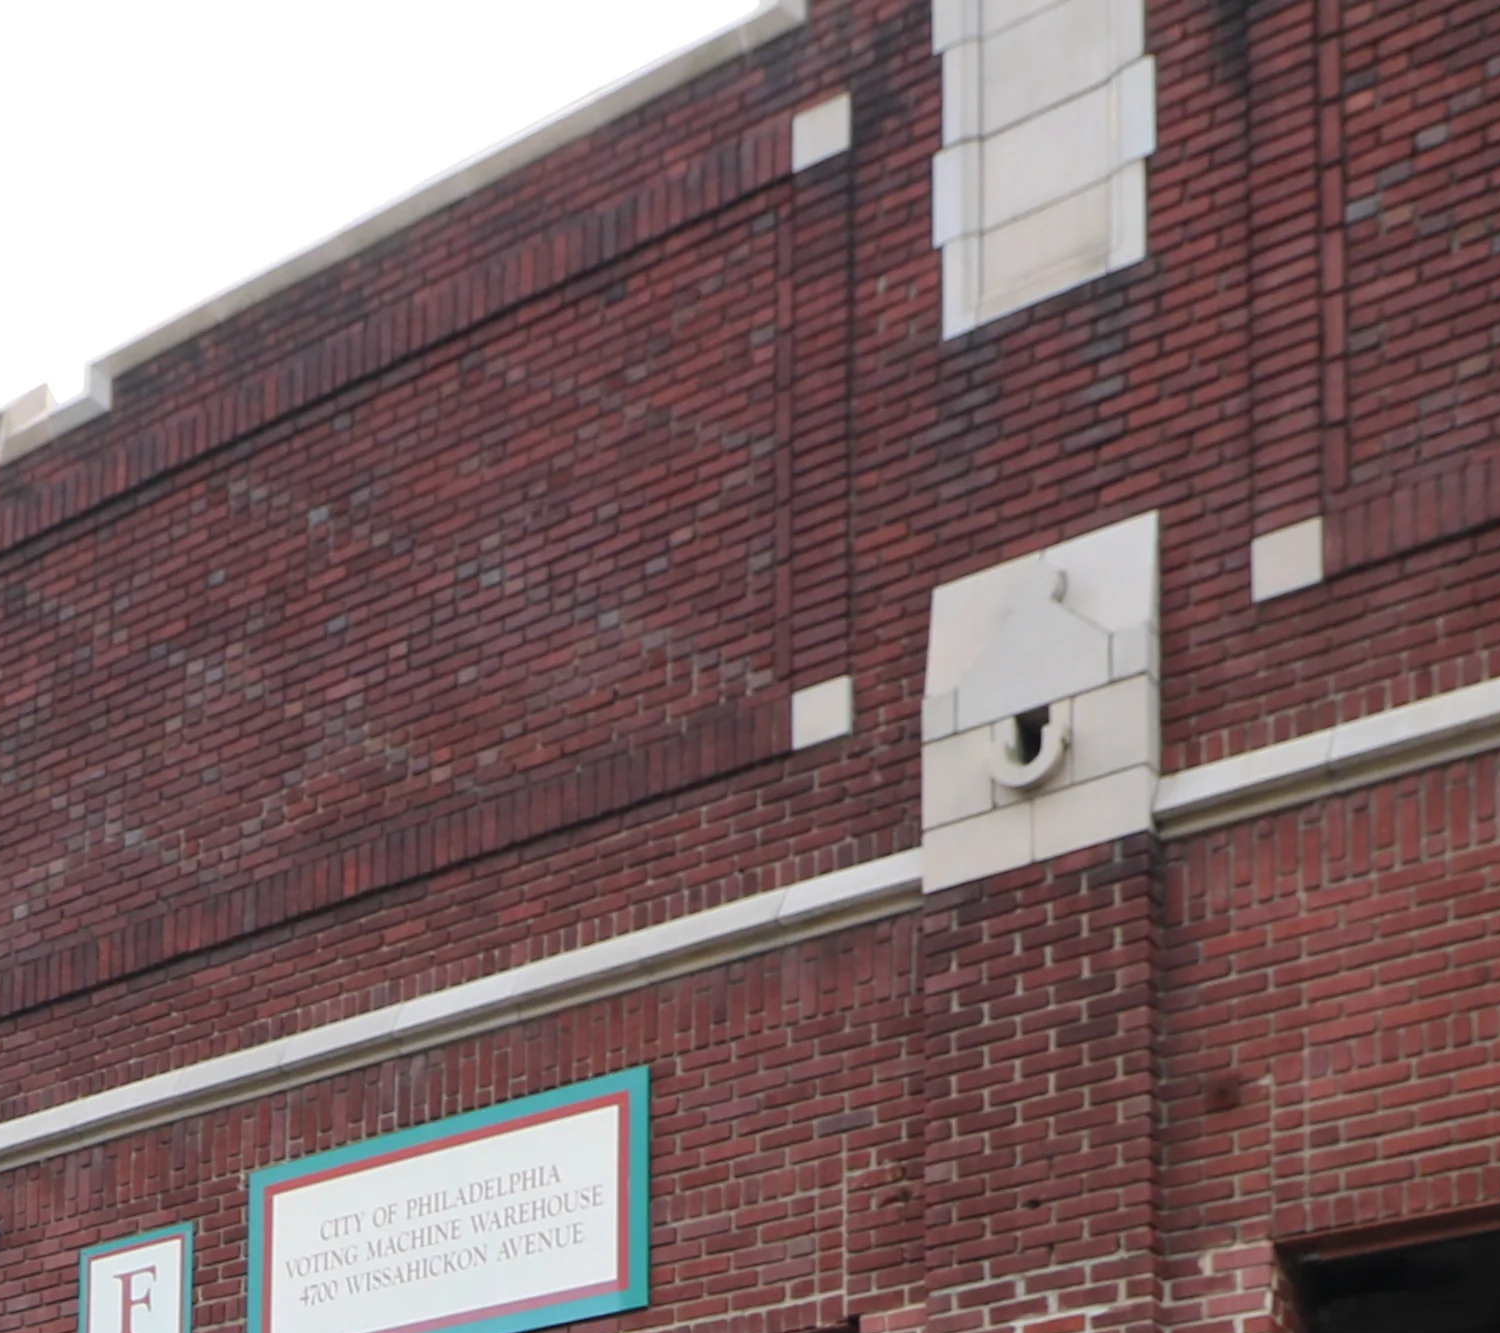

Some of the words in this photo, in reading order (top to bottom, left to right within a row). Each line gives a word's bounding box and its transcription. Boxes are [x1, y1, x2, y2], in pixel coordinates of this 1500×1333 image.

[284, 1245, 358, 1279] VOTING
[366, 1219, 461, 1261] MACHINE
[469, 1184, 604, 1234] WAREHOUSE
[319, 1211, 365, 1241] CITY
[372, 1203, 399, 1229] OF
[405, 1163, 561, 1220] PHILADELPHIA
[299, 1279, 338, 1307] 4700
[344, 1243, 488, 1297] WISSAHICKON
[495, 1221, 586, 1263] AVENUE
